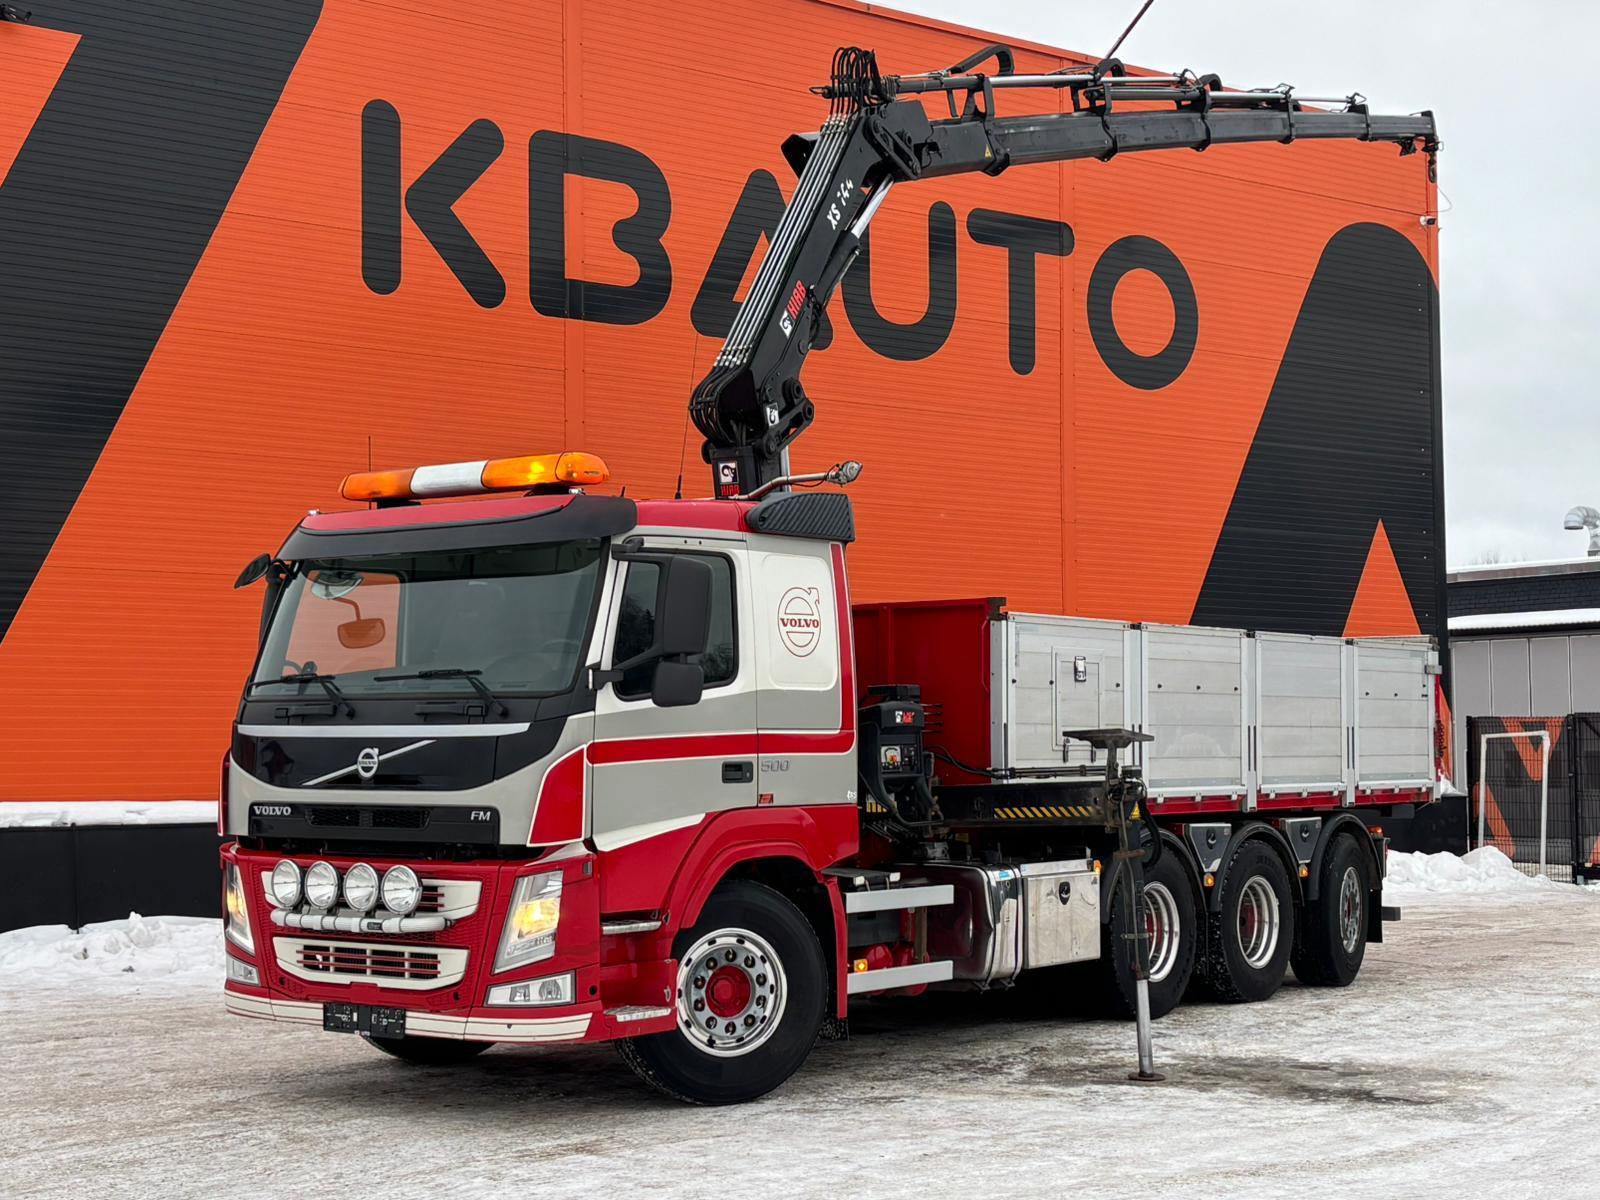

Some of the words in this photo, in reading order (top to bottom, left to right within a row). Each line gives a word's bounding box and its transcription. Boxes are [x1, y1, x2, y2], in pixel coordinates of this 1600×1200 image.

[826, 203, 841, 231] XS
[786, 279, 807, 320] HIAB
[780, 617, 820, 629] VOLVO
[761, 759, 790, 773] 500
[253, 805, 292, 816] VOLVO
[470, 810, 491, 821] FM
